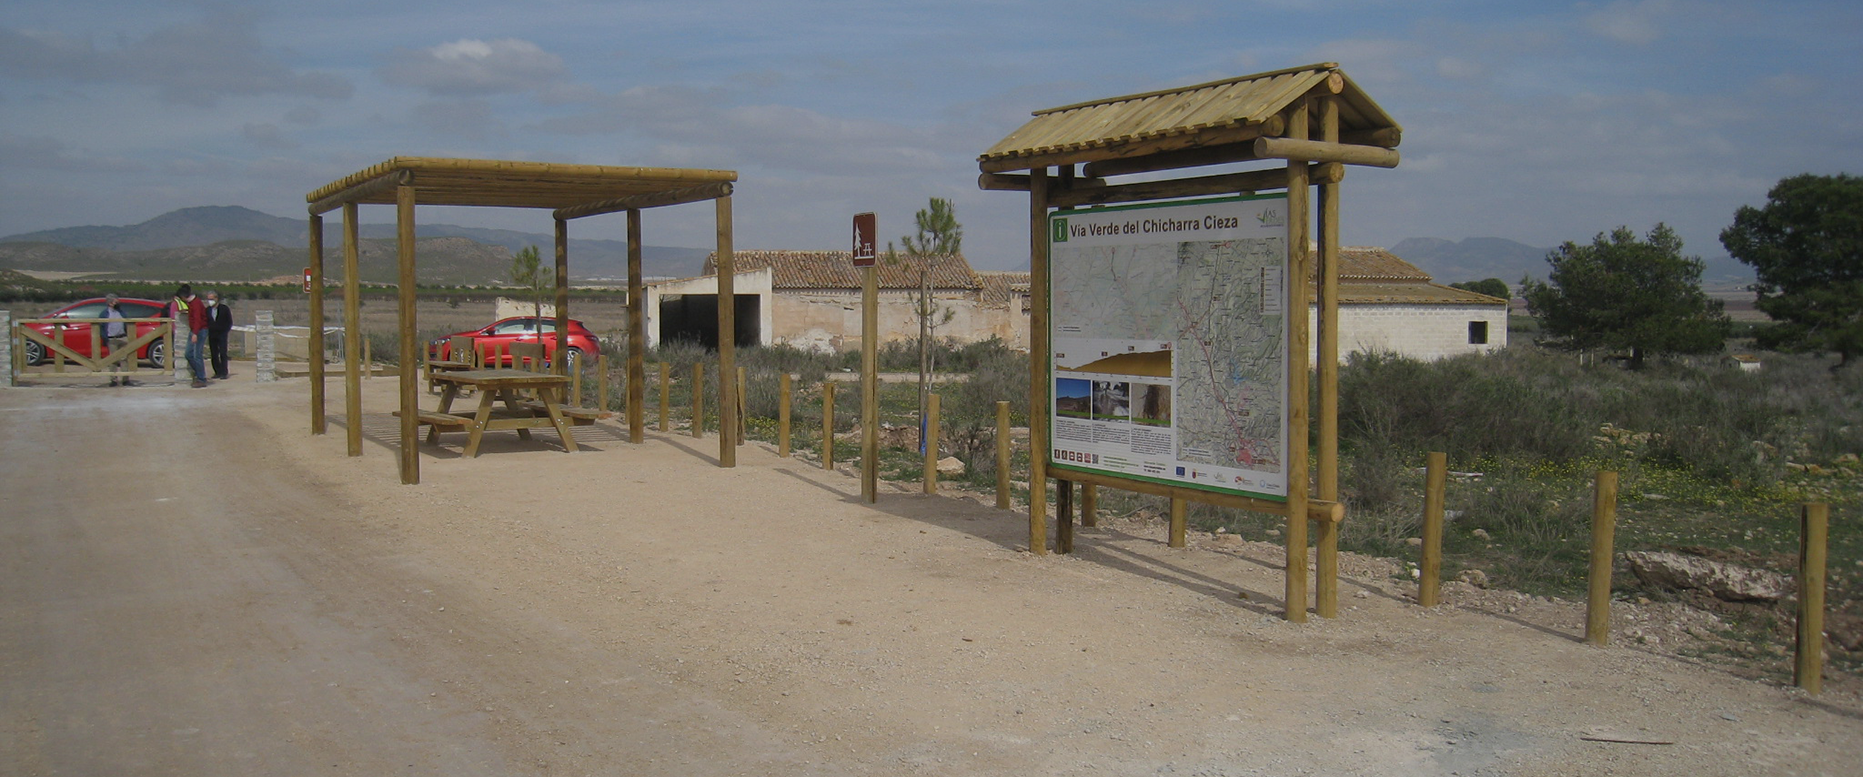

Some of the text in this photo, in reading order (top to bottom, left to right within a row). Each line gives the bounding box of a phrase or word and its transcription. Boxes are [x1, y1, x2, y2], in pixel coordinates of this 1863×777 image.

[1070, 224, 1087, 237] Vía
[1089, 222, 1119, 236] Verde
[1123, 220, 1139, 234] del
[1143, 216, 1200, 233] Chicharra
[1204, 215, 1238, 230] Cieza
